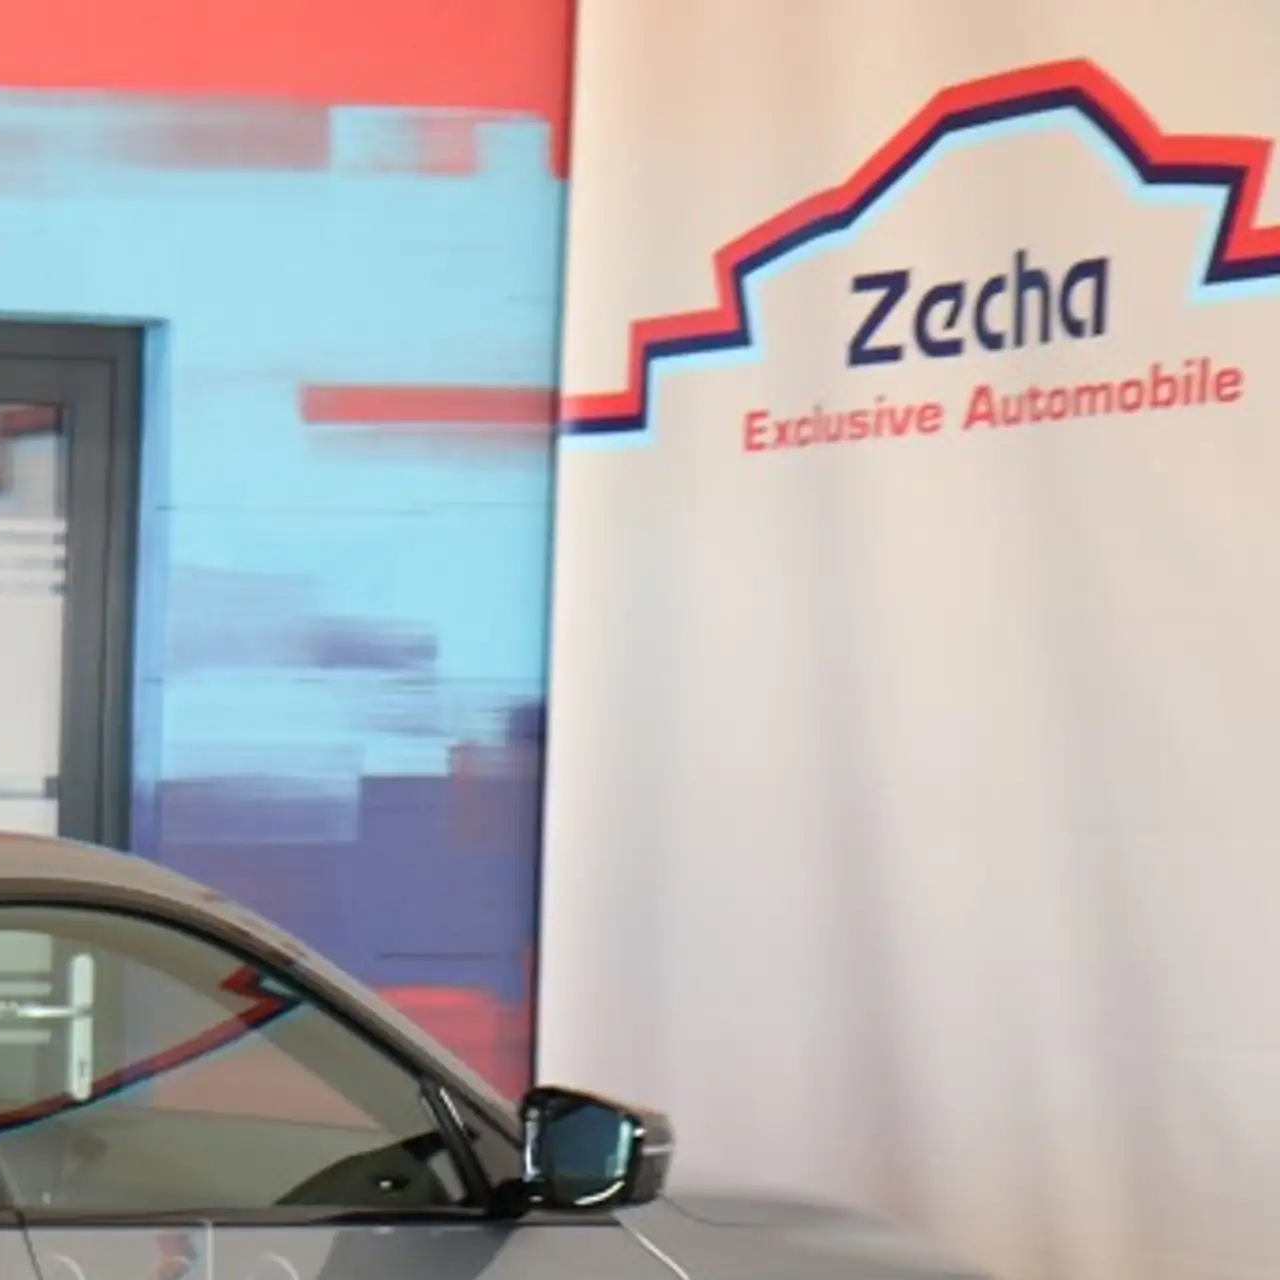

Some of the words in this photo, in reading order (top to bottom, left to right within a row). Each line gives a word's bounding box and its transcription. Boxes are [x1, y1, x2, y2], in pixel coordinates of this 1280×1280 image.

[846, 248, 1110, 367] Zecha
[742, 394, 945, 453] Exclusive
[962, 357, 1245, 432] Automobile
